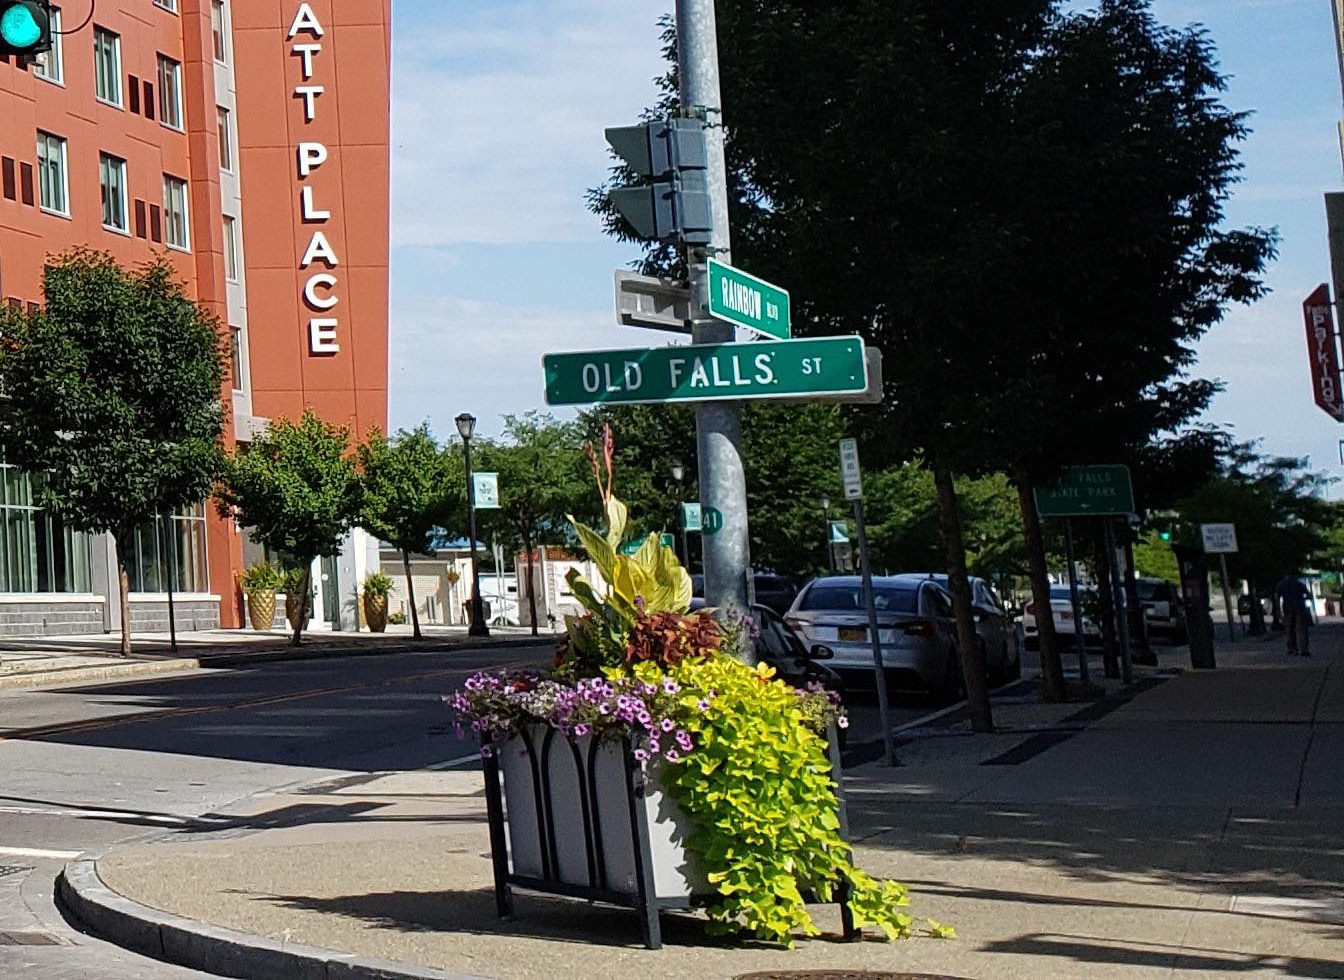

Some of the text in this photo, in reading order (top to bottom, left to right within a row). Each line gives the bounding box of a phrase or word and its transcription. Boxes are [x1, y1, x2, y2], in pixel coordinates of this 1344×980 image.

[299, 142, 340, 353] PLACE
[721, 276, 762, 321] RAINBOW
[582, 353, 822, 394] OLD FALLS ST
